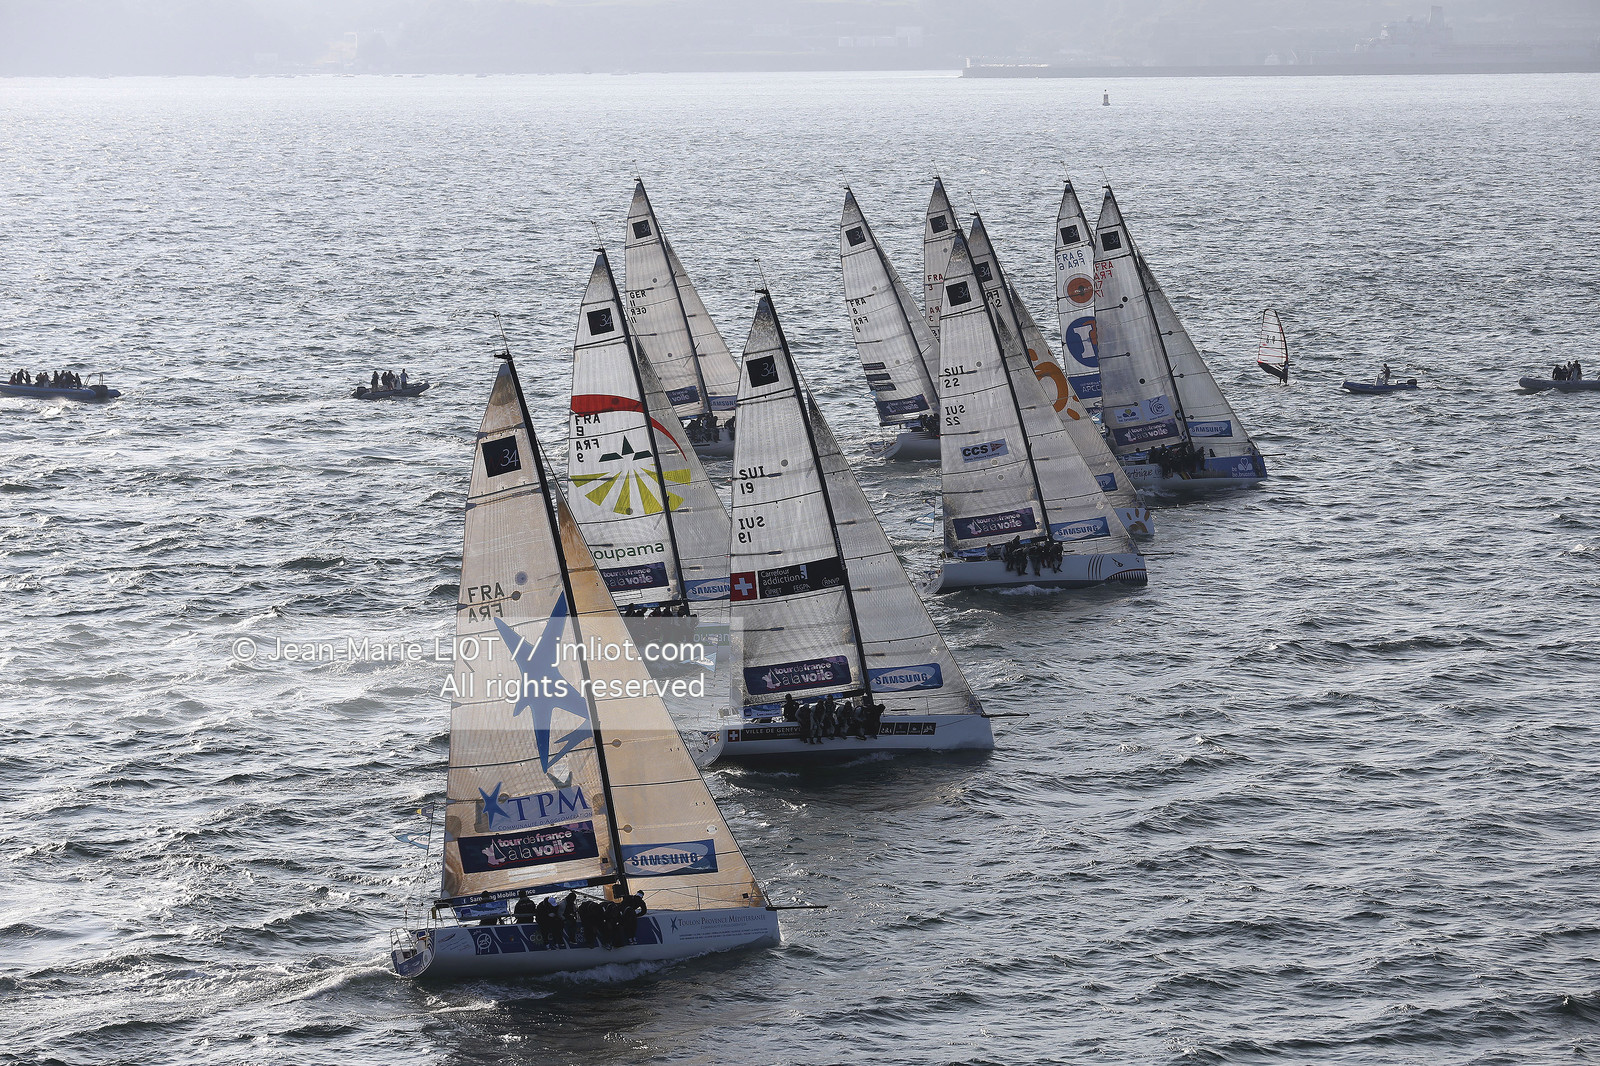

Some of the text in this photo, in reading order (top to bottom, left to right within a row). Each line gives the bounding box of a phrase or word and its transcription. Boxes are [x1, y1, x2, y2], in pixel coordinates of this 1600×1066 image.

[1056, 250, 1084, 263] FRA 6
[1094, 261, 1114, 271] FRA
[927, 274, 943, 282] FRA
[630, 290, 647, 299] GER
[850, 298, 867, 308] FRA
[599, 313, 613, 327] 34
[760, 362, 777, 377] 34
[944, 365, 966, 376] SUI
[944, 378, 960, 389] 22
[575, 414, 601, 426] FRA
[962, 445, 989, 457] CCS
[500, 448, 519, 467] 34
[738, 466, 765, 481] SUI
[740, 482, 755, 495] 19
[997, 519, 1023, 530] voile
[1058, 524, 1098, 536] SAMSUNG
[593, 542, 665, 562] oupama
[625, 573, 654, 585] voile
[760, 567, 790, 579] Carrefour
[467, 582, 505, 603] FRA
[691, 584, 730, 596] SAMSUN
[800, 669, 834, 683] voile
[875, 672, 928, 685] SAMSUNG
[507, 786, 591, 821] TPM
[532, 838, 575, 857] voile
[631, 852, 700, 867] SAMSUNG
[496, 889, 519, 899] Mobile
